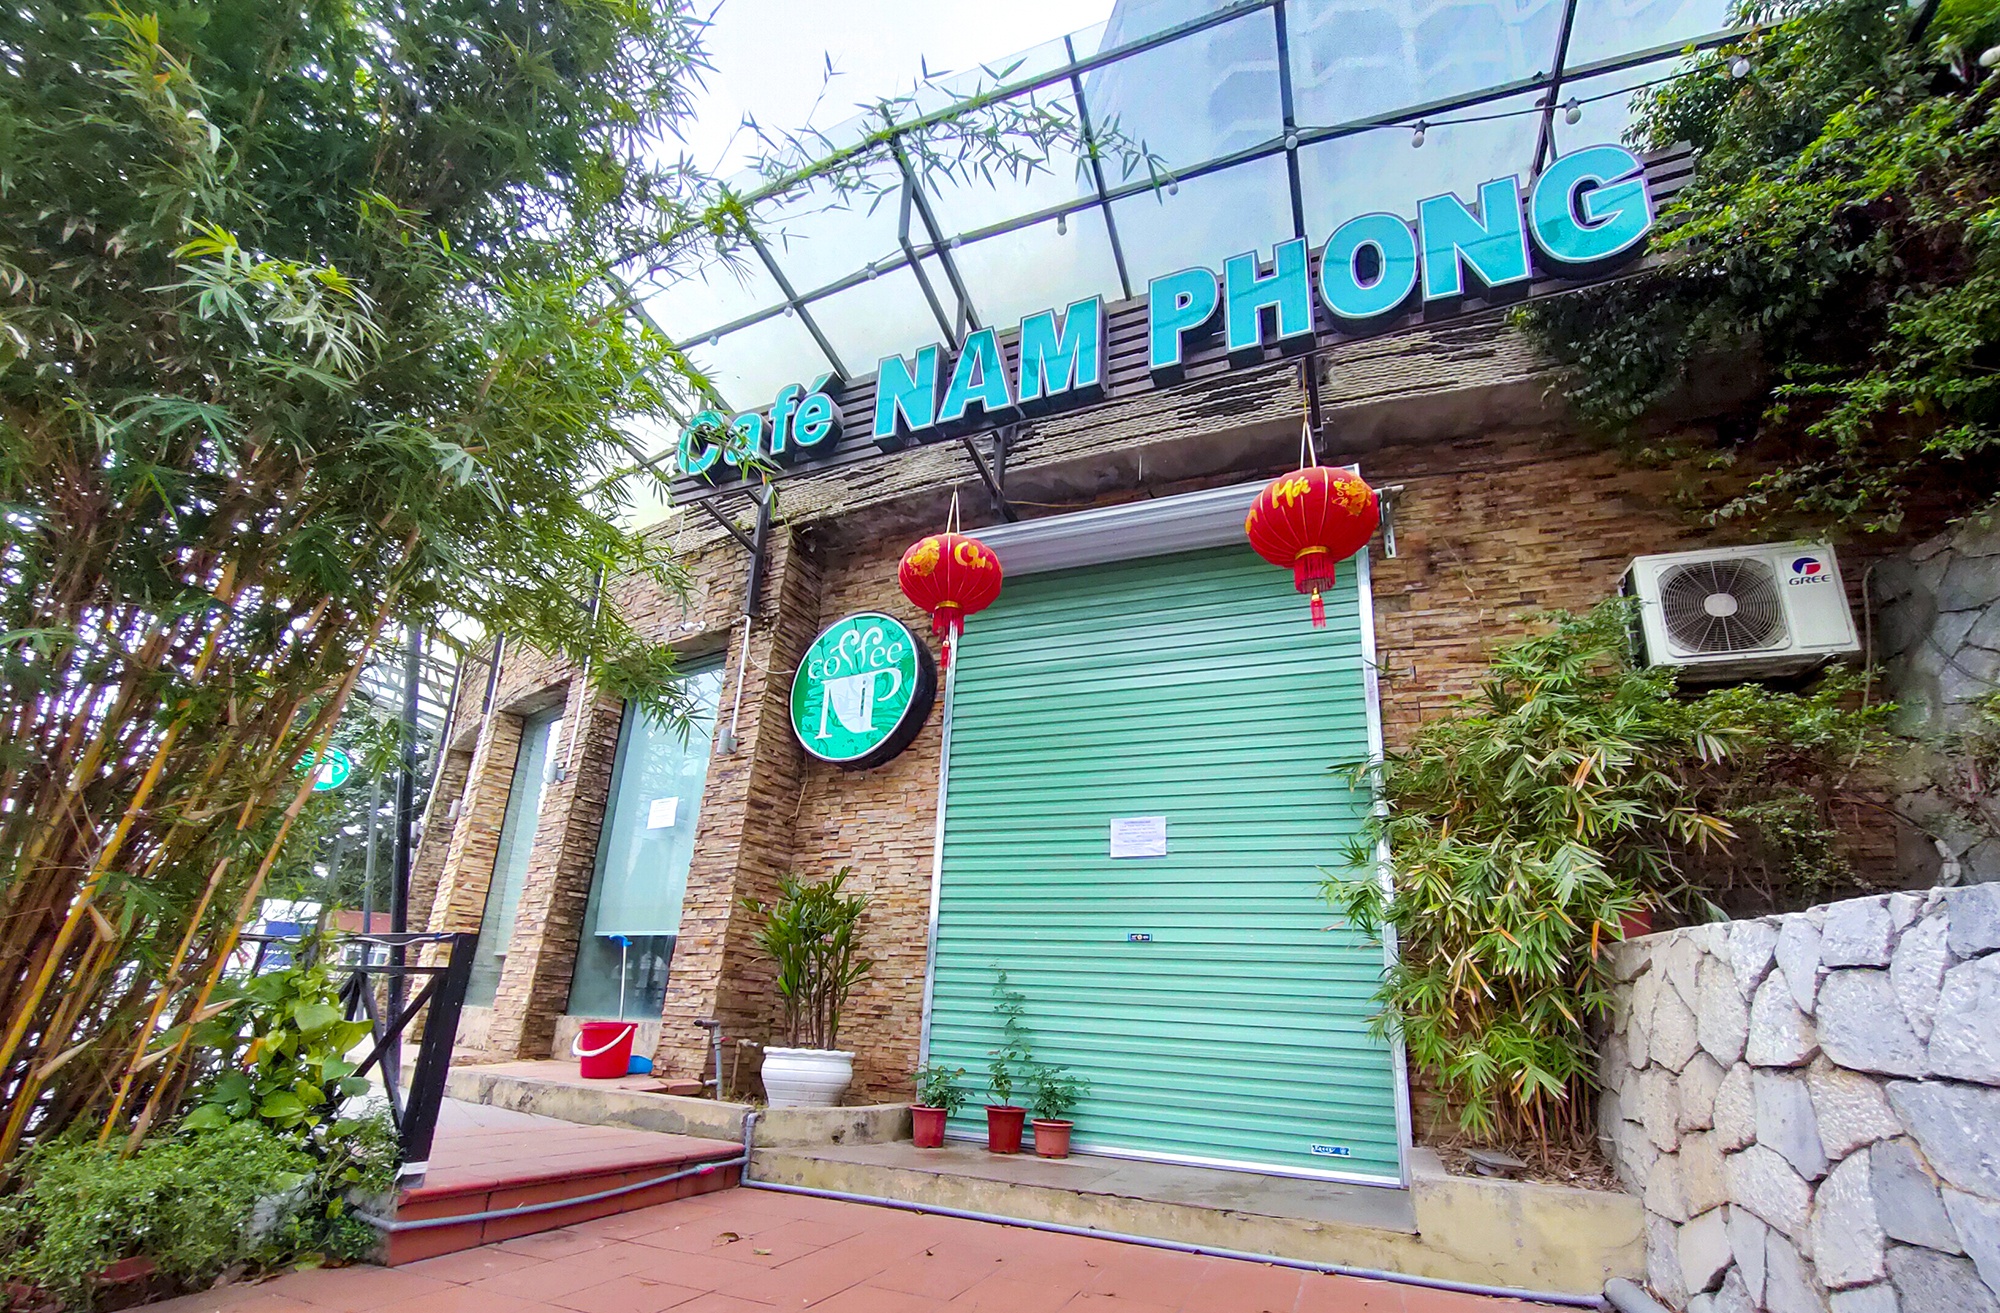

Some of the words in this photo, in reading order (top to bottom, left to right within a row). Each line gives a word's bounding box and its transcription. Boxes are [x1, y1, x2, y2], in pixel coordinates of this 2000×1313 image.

[677, 373, 833, 476] Café
[873, 297, 1100, 440] NAM
[1148, 143, 1653, 370] PHONG
[1789, 574, 1831, 586] GREE
[808, 626, 903, 680] coffee
[272, 908, 312, 917] NOVEL
